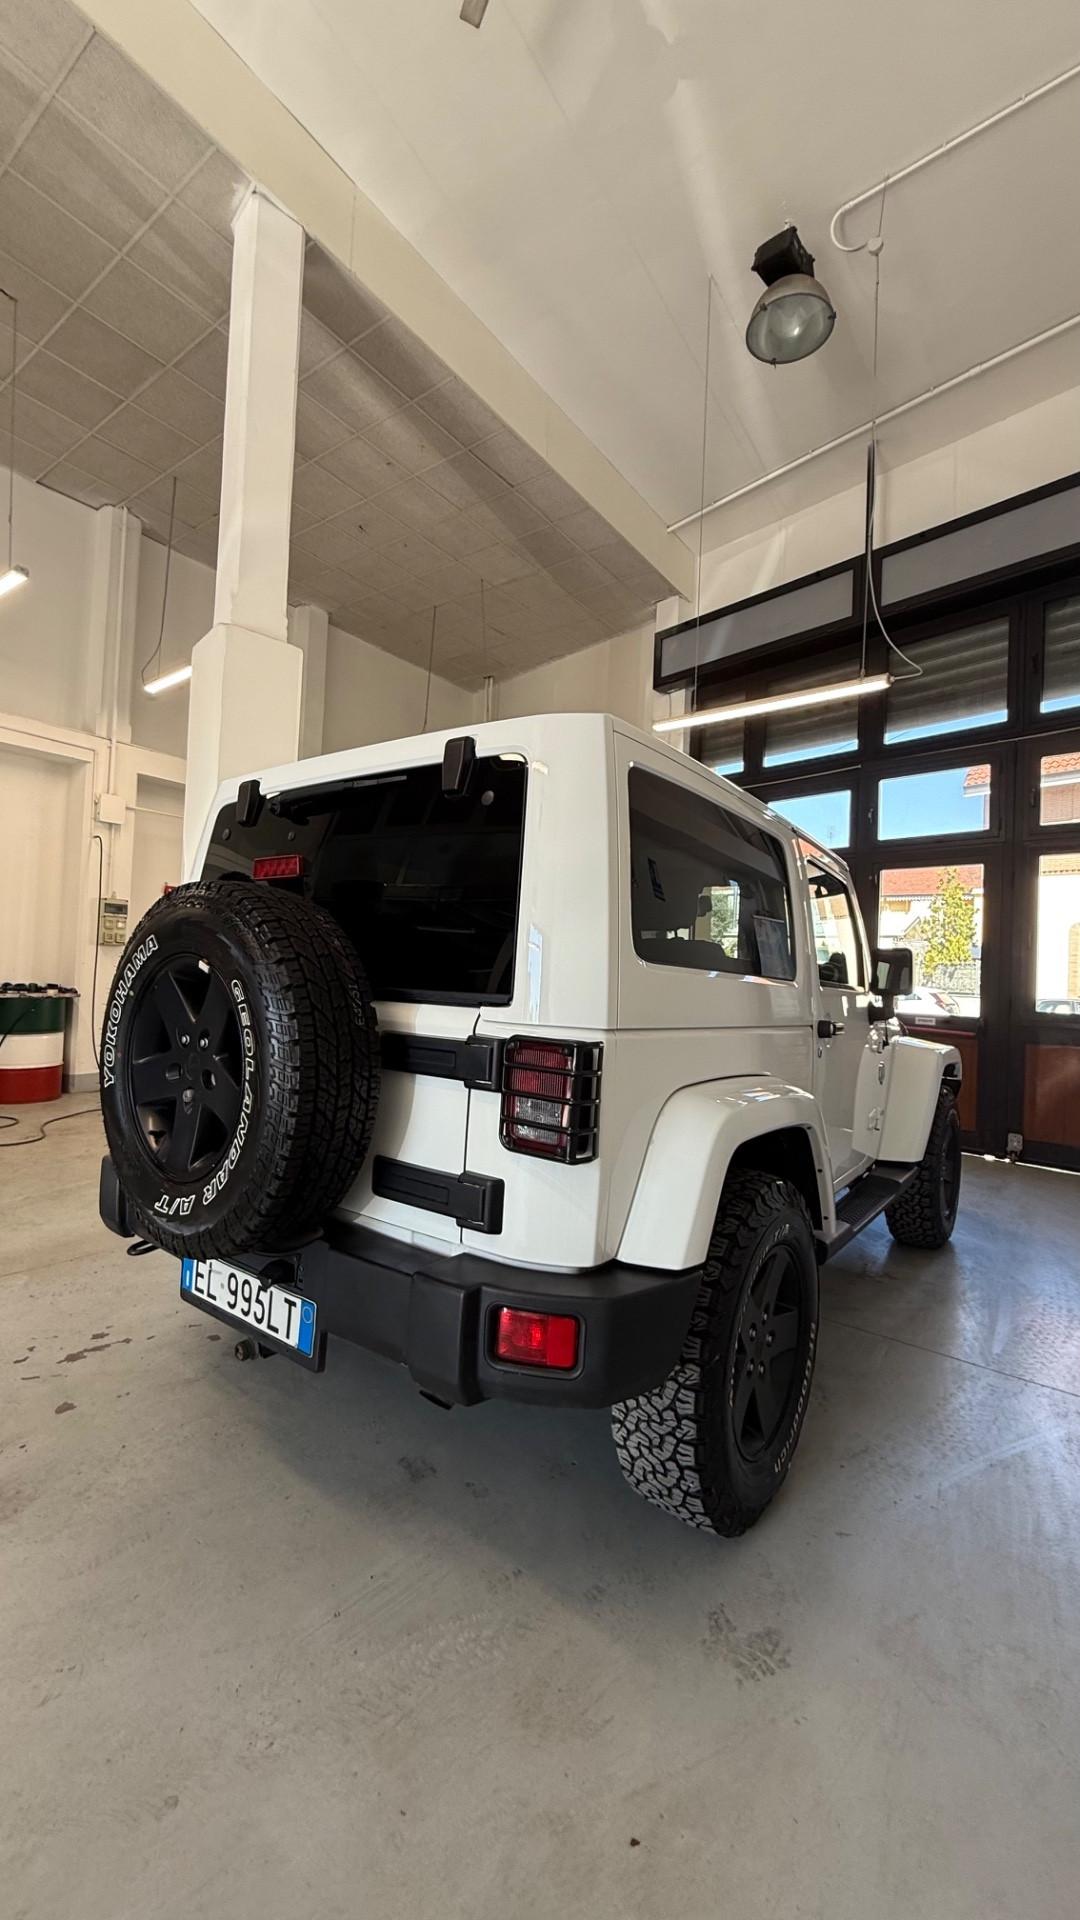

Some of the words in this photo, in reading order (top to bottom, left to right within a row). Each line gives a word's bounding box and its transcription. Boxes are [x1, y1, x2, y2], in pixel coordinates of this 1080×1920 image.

[104, 934, 158, 1088] YOKOHAMA
[202, 979, 254, 1206] GEOLANDAR
[154, 1194, 196, 1216] A/T
[194, 1260, 216, 1301] EL
[227, 1272, 297, 1340] 995LT
